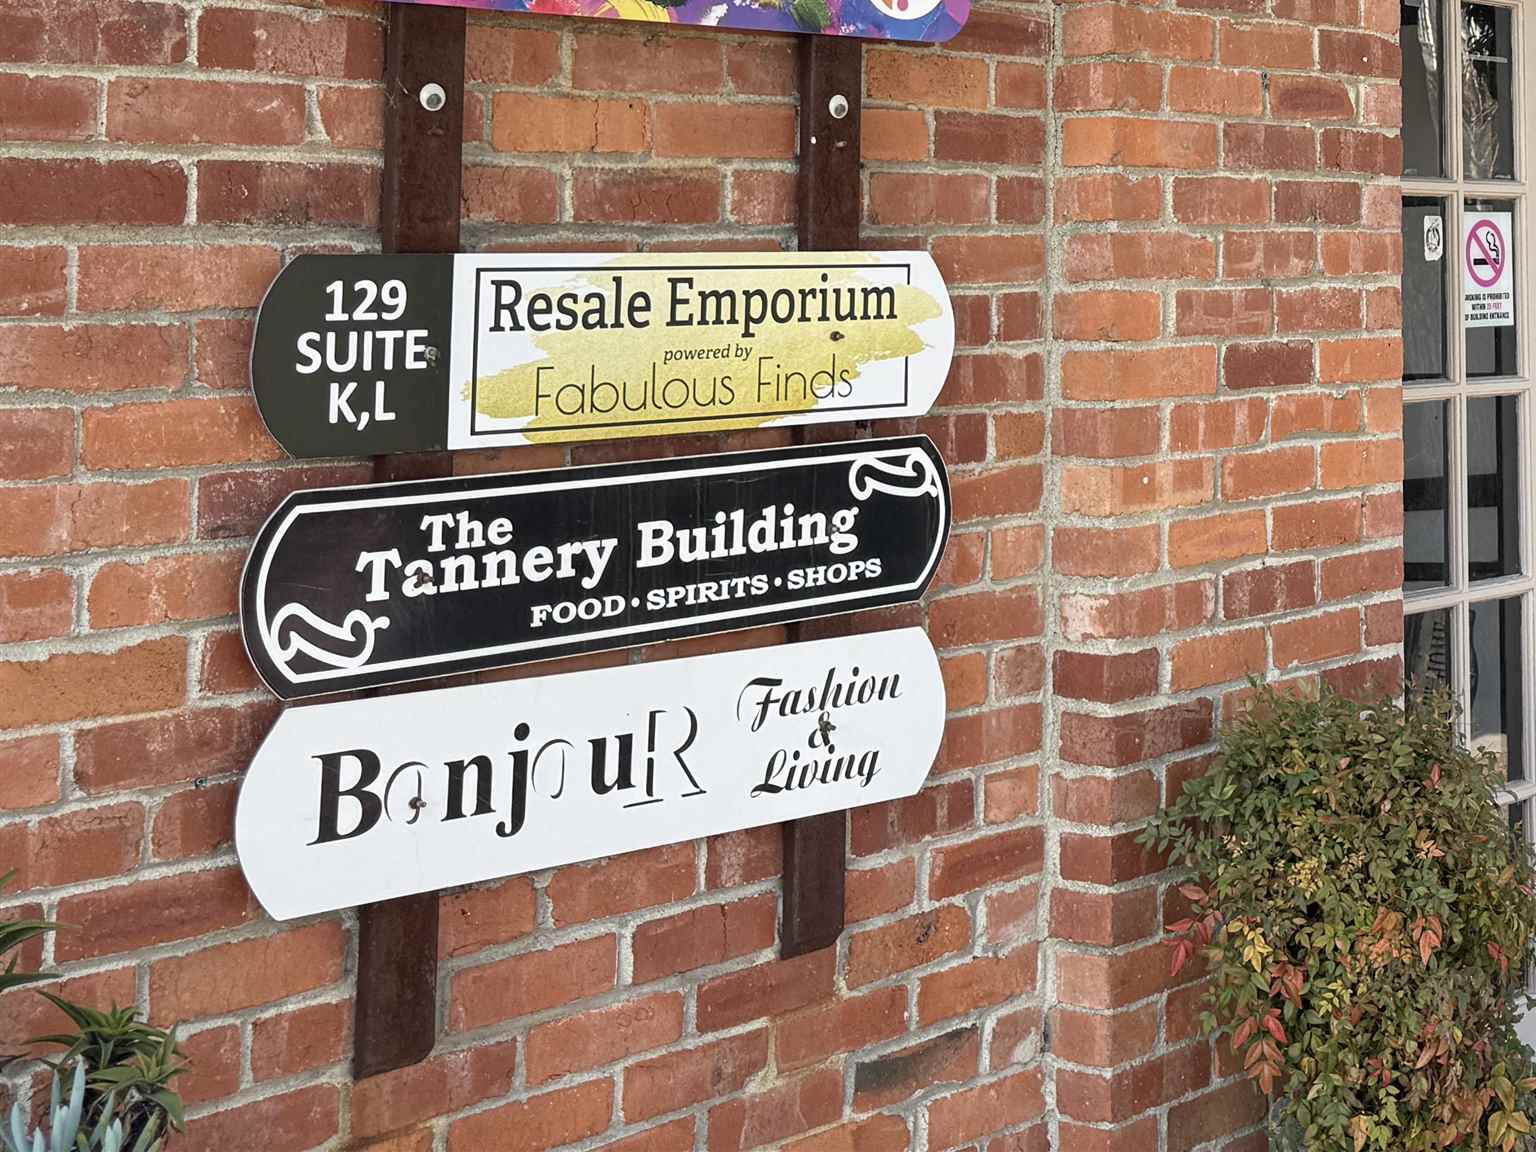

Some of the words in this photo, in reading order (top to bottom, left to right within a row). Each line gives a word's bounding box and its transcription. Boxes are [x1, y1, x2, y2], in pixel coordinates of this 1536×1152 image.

[324, 279, 408, 322] 129
[489, 277, 652, 333] Resale
[665, 273, 899, 338] Emporium
[296, 329, 429, 375] SUITE
[662, 346, 731, 365] powered
[733, 344, 752, 363] by
[328, 381, 396, 432] K,L
[535, 366, 736, 417] Fabulous
[756, 354, 853, 404] Finds
[355, 536, 618, 603] Tannery
[636, 504, 859, 569] Building
[420, 511, 513, 552] The
[737, 666, 903, 732] Fashion
[808, 716, 836, 750] &
[750, 744, 882, 798] Living
